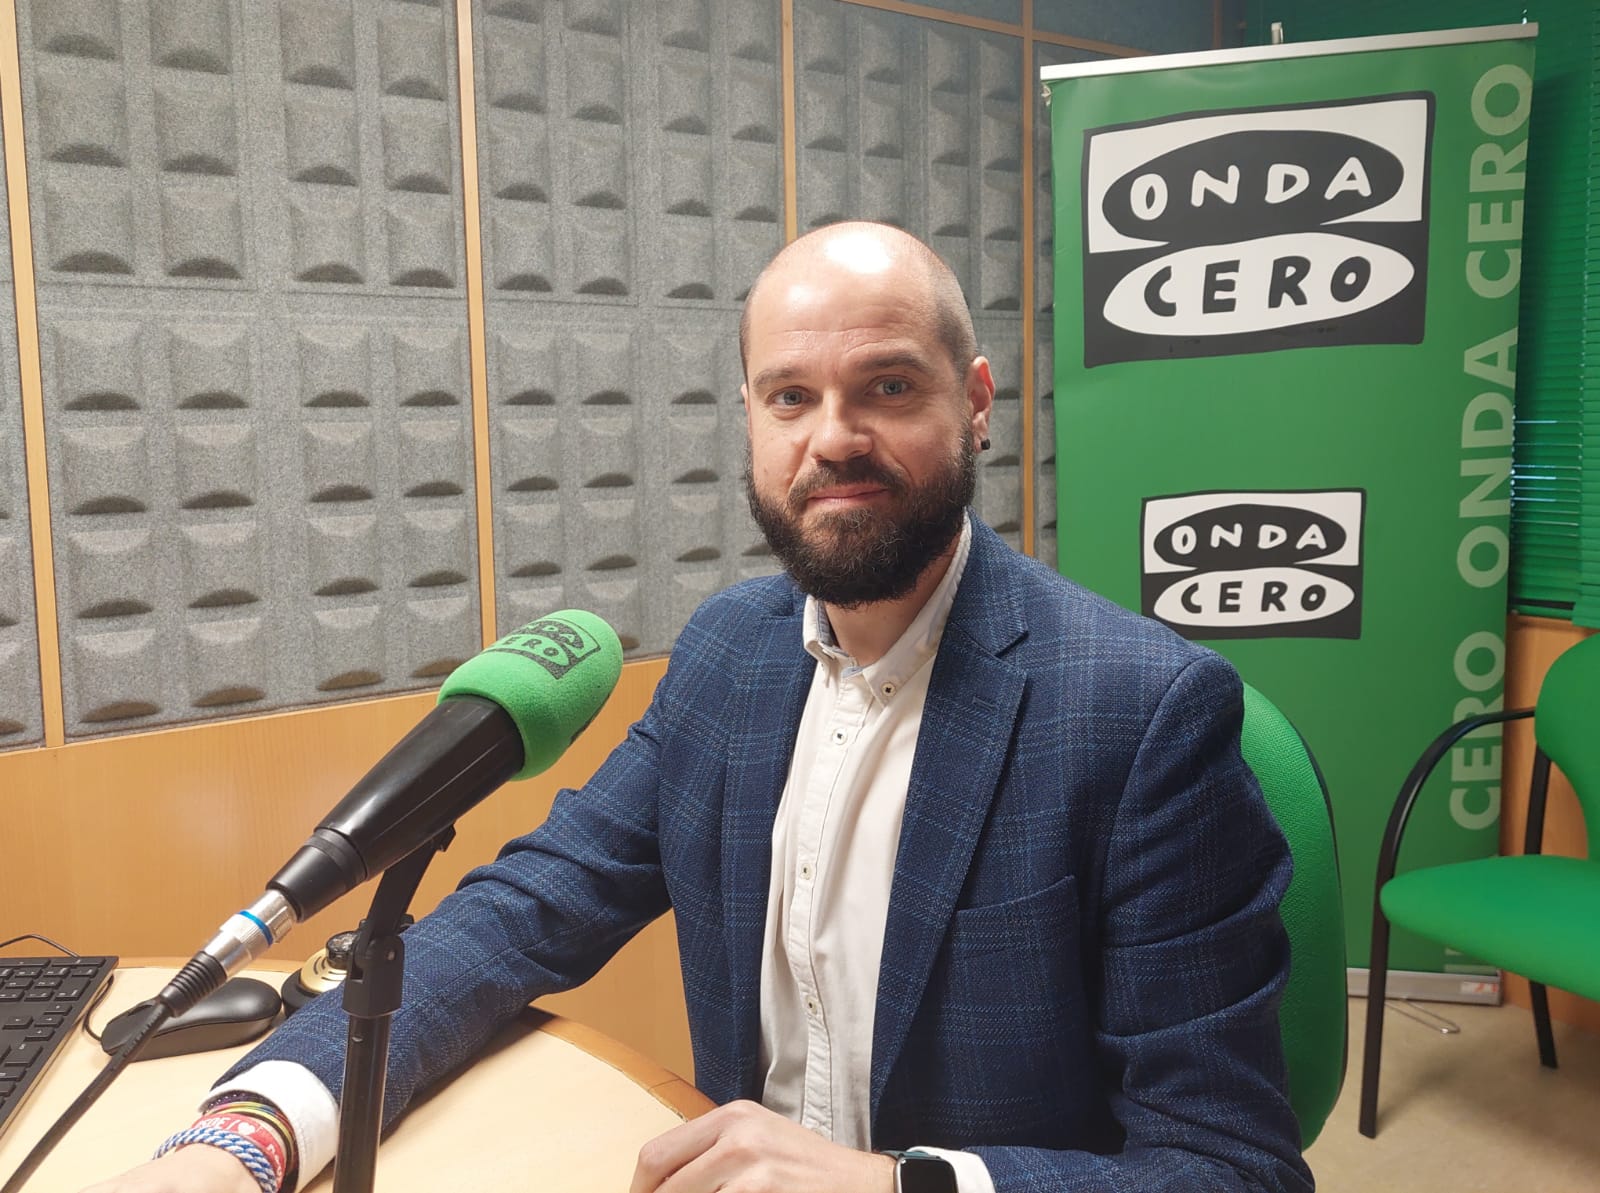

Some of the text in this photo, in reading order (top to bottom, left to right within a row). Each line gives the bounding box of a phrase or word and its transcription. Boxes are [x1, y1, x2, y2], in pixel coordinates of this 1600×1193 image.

[1130, 157, 1372, 221] ONDA
[1466, 64, 1534, 299] CERO
[1144, 256, 1372, 317] CERO
[1456, 327, 1519, 588] ONDA
[1171, 523, 1327, 555] ONDA
[1181, 581, 1327, 614] CERO
[502, 636, 560, 657] ERO
